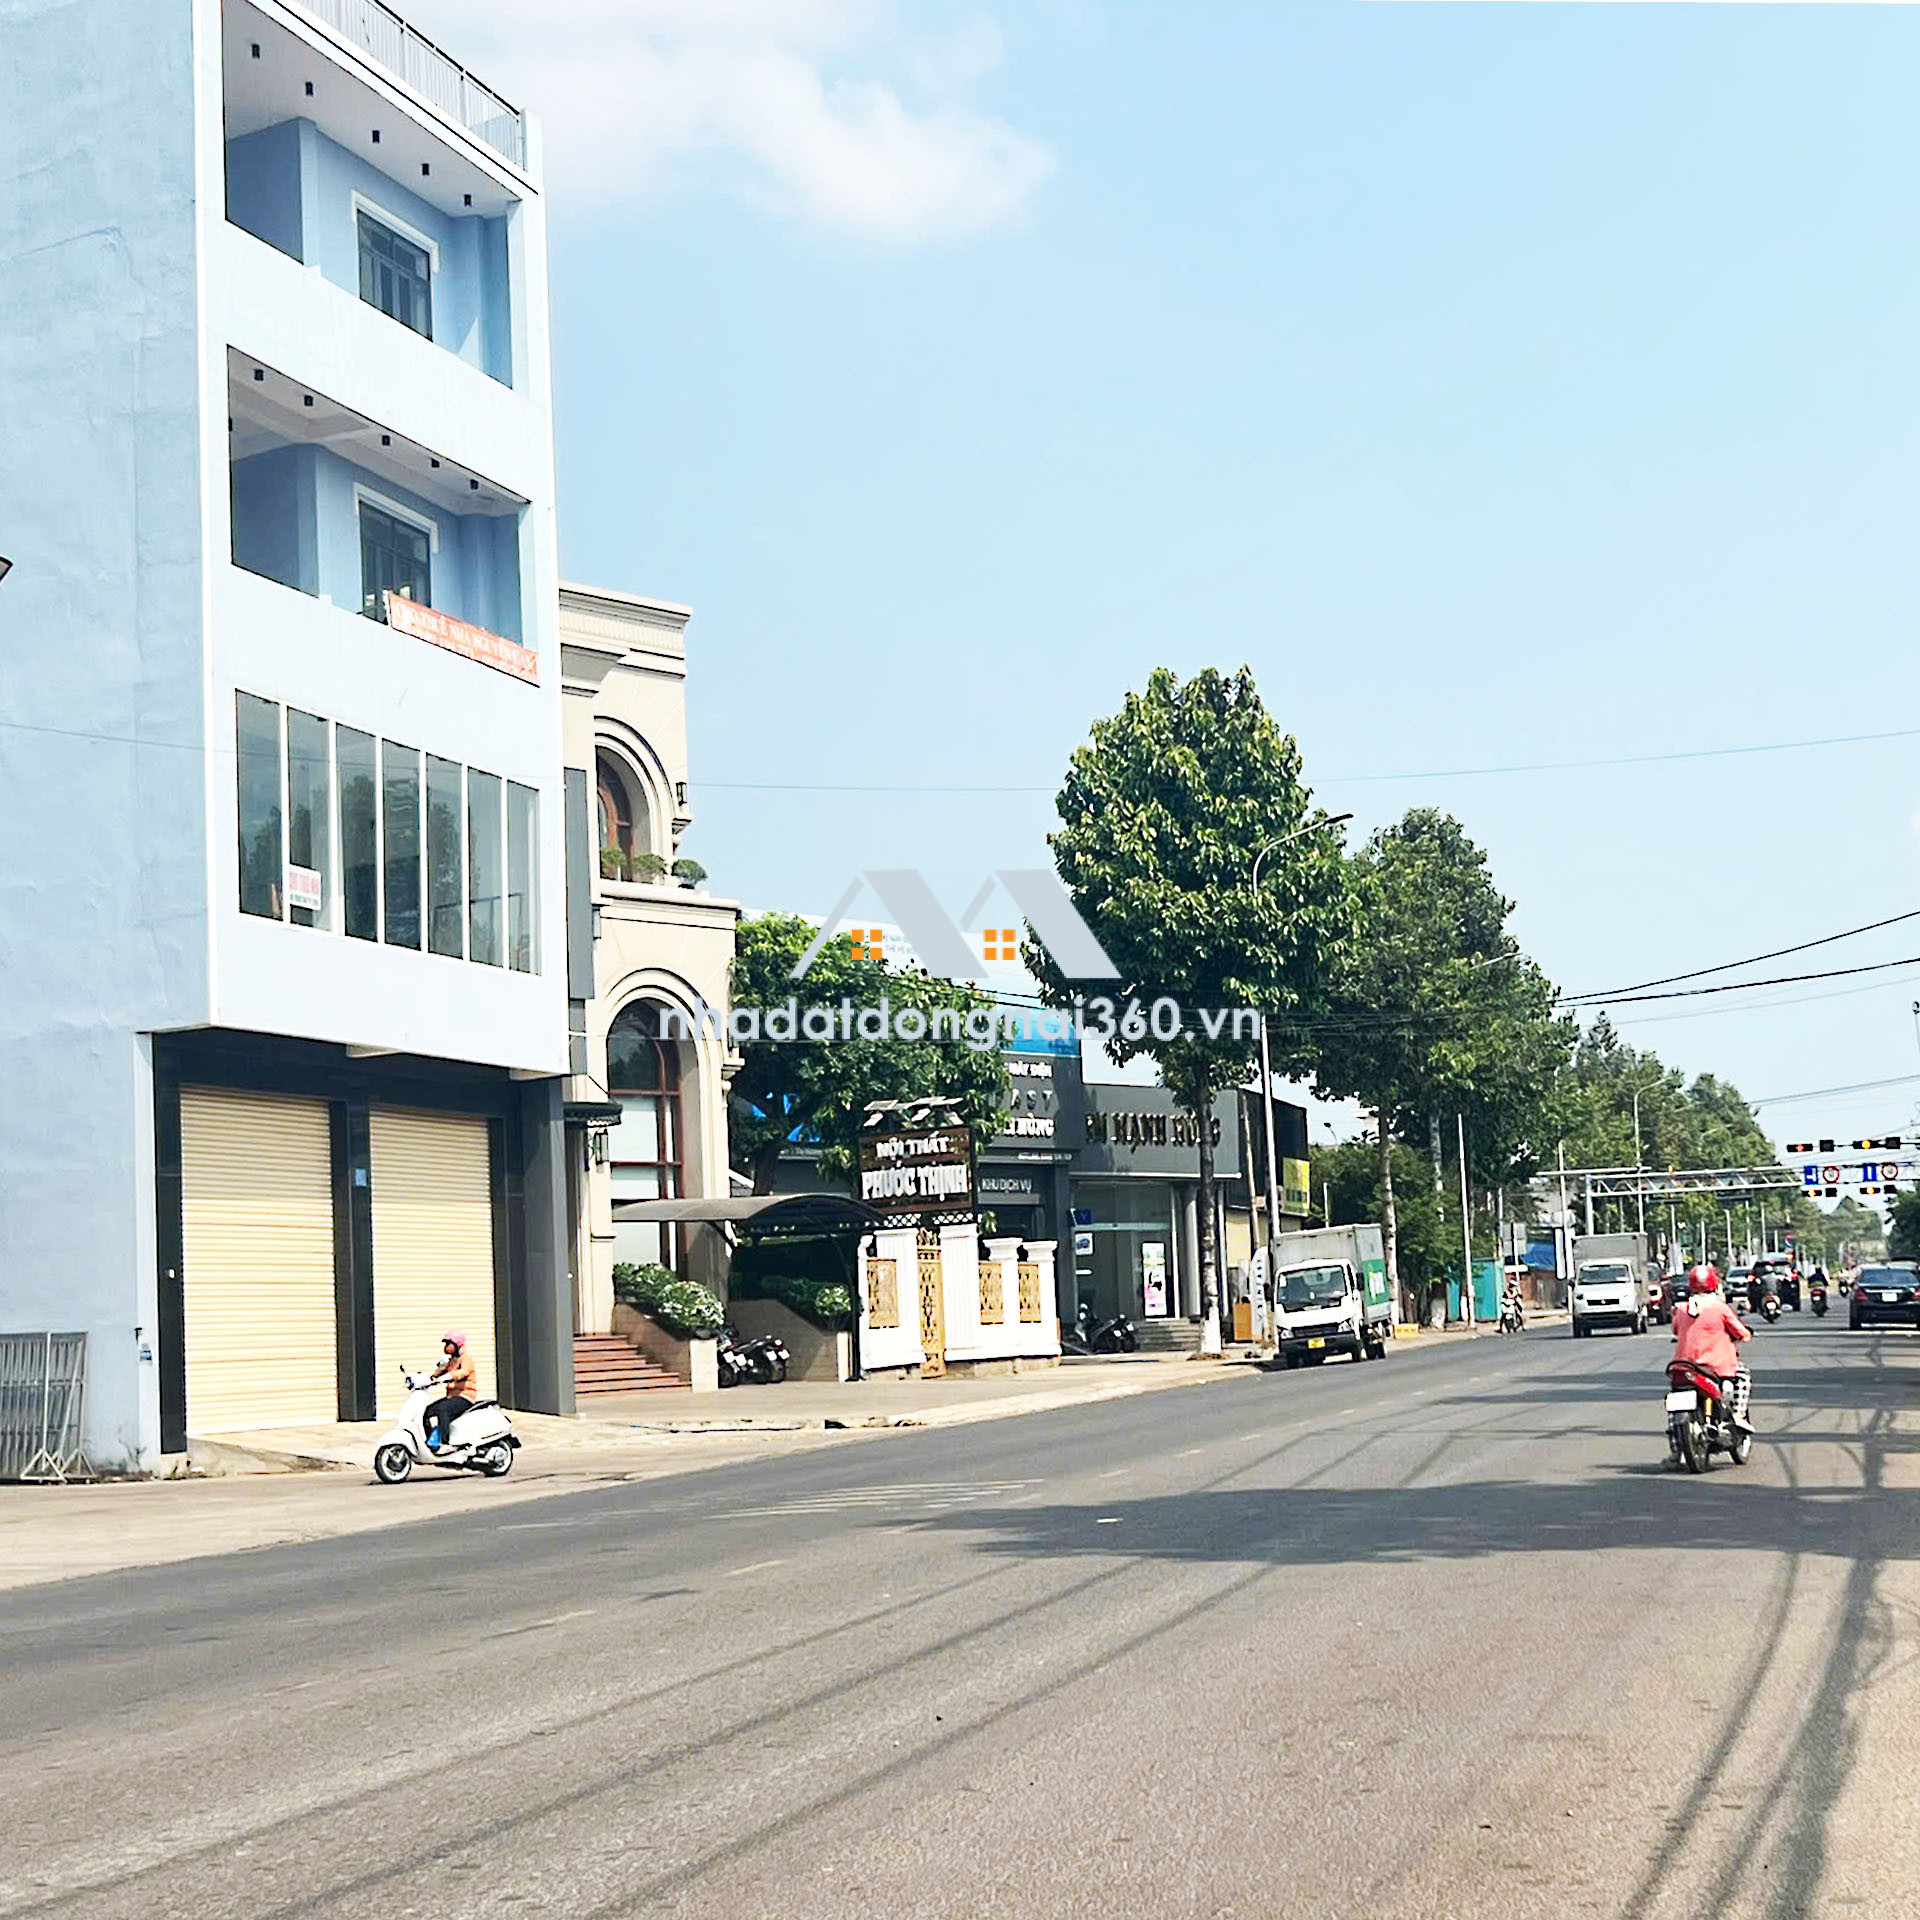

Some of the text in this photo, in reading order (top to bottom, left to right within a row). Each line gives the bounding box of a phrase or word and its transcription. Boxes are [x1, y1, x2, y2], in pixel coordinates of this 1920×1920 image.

[1010, 1088, 1054, 1111] AST
[876, 1130, 949, 1160] NỘI THẤT
[861, 1160, 968, 1202] PHƯỚC THỊNH
[1000, 1178, 1019, 1193] DỊCH
[1020, 1178, 1032, 1193] VỤ
